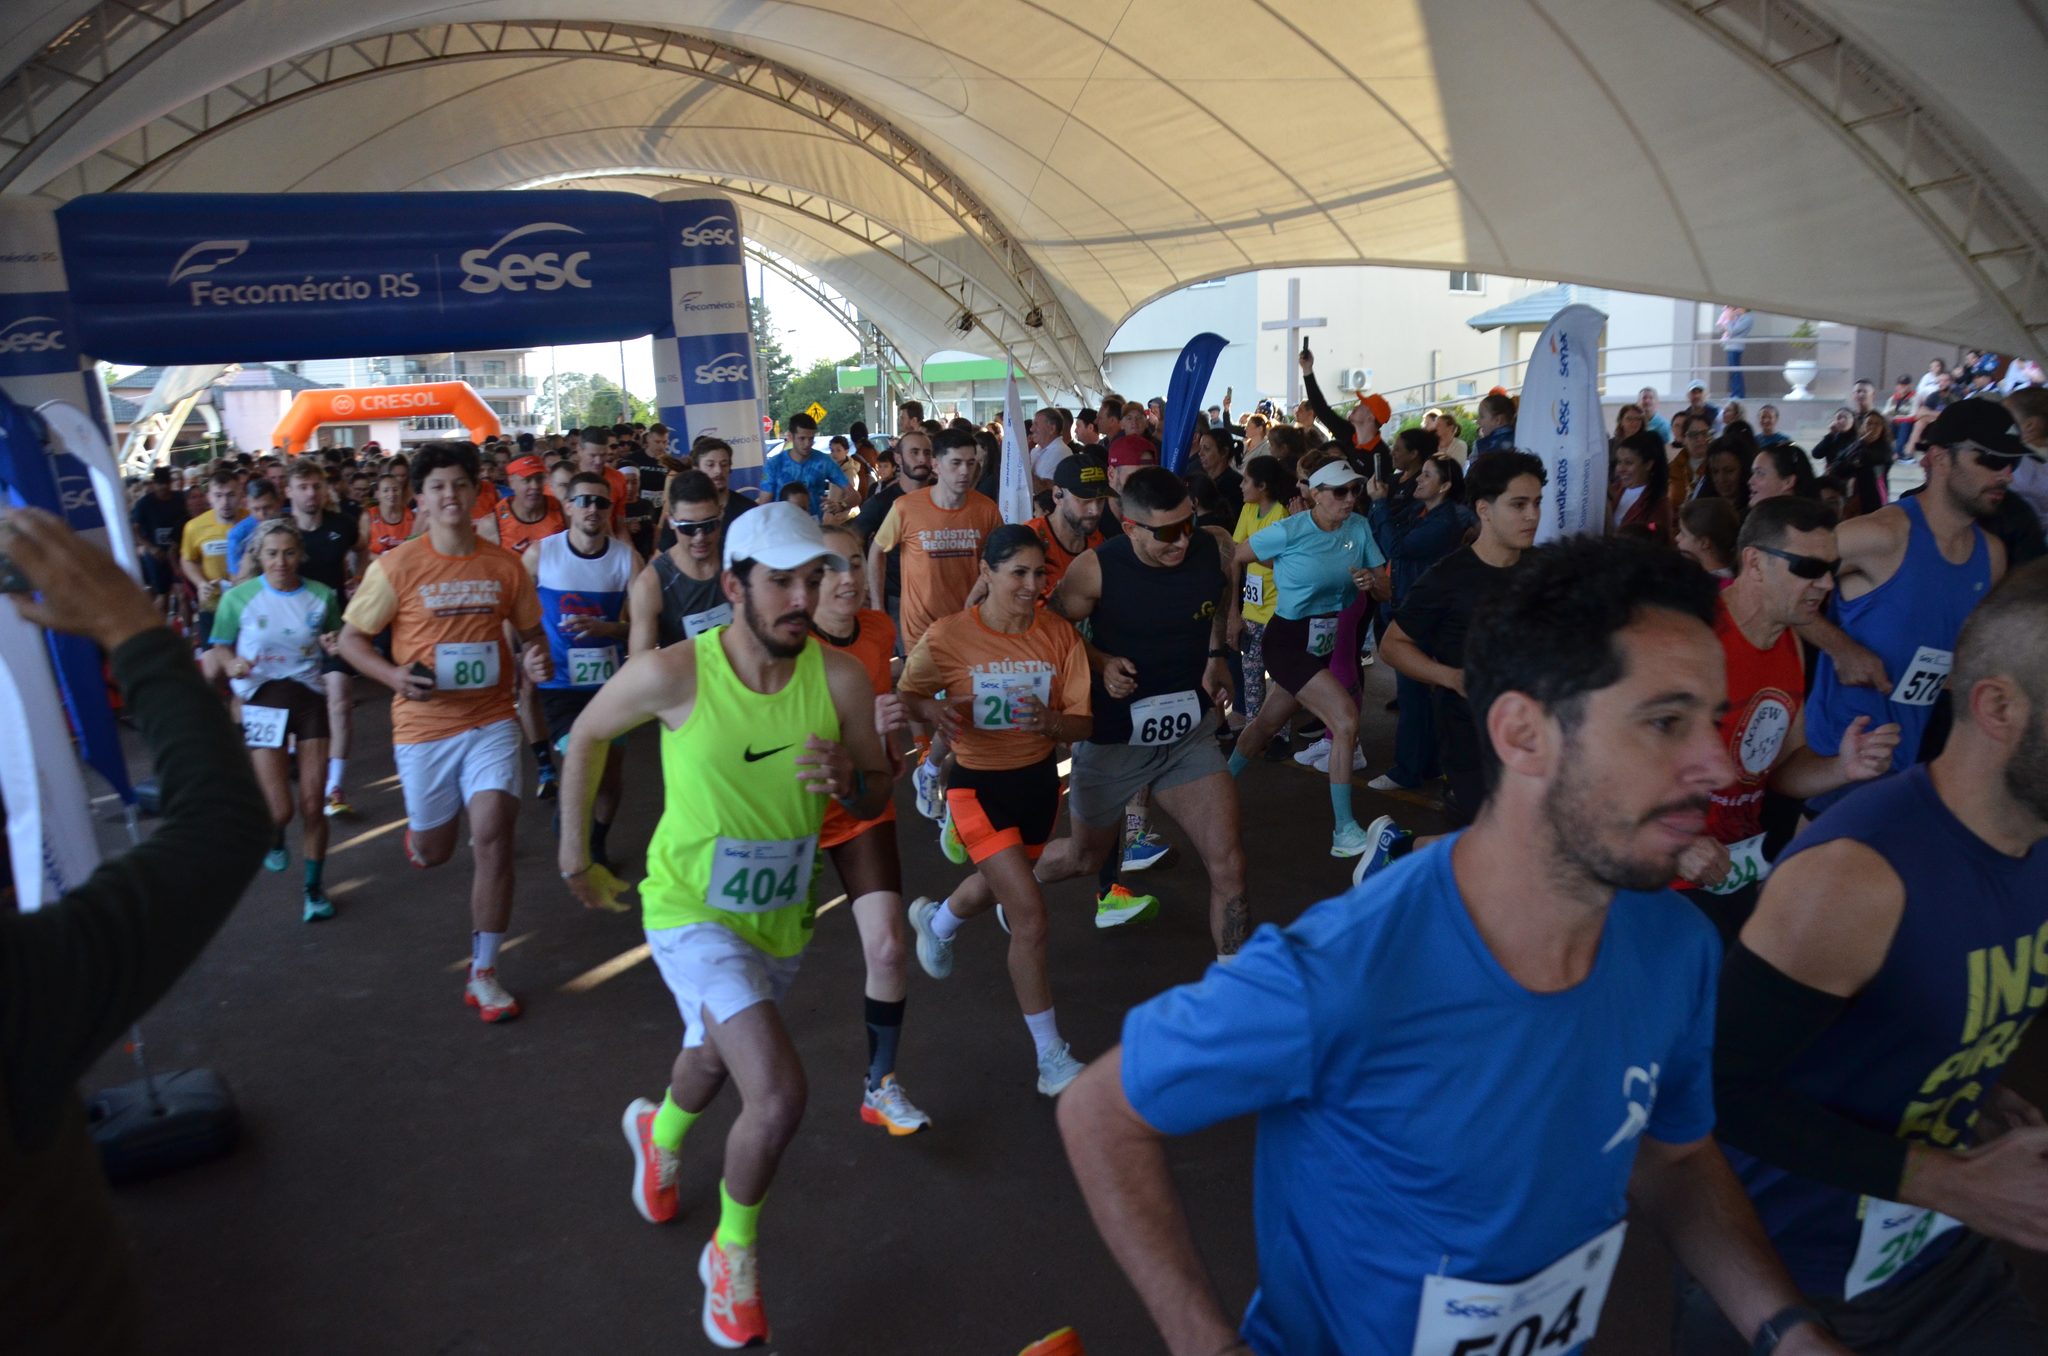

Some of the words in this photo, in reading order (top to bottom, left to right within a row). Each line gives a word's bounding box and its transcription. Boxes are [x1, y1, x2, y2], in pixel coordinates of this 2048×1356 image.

[681, 226, 736, 247] Sesc
[459, 247, 592, 294] Sesc
[191, 276, 372, 307] Fecomércio
[379, 272, 420, 299] RS
[684, 301, 735, 312] Fecomércio
[0, 330, 67, 353] esc
[694, 363, 749, 385] Sesc
[360, 391, 440, 411] CRESOL
[1557, 399, 1570, 436] Sesc
[922, 539, 977, 551] REGIONAL
[1244, 584, 1259, 602] 93
[456, 660, 486, 686] 80
[576, 660, 614, 683] 270
[1141, 712, 1192, 743] 689
[721, 863, 799, 906] 404
